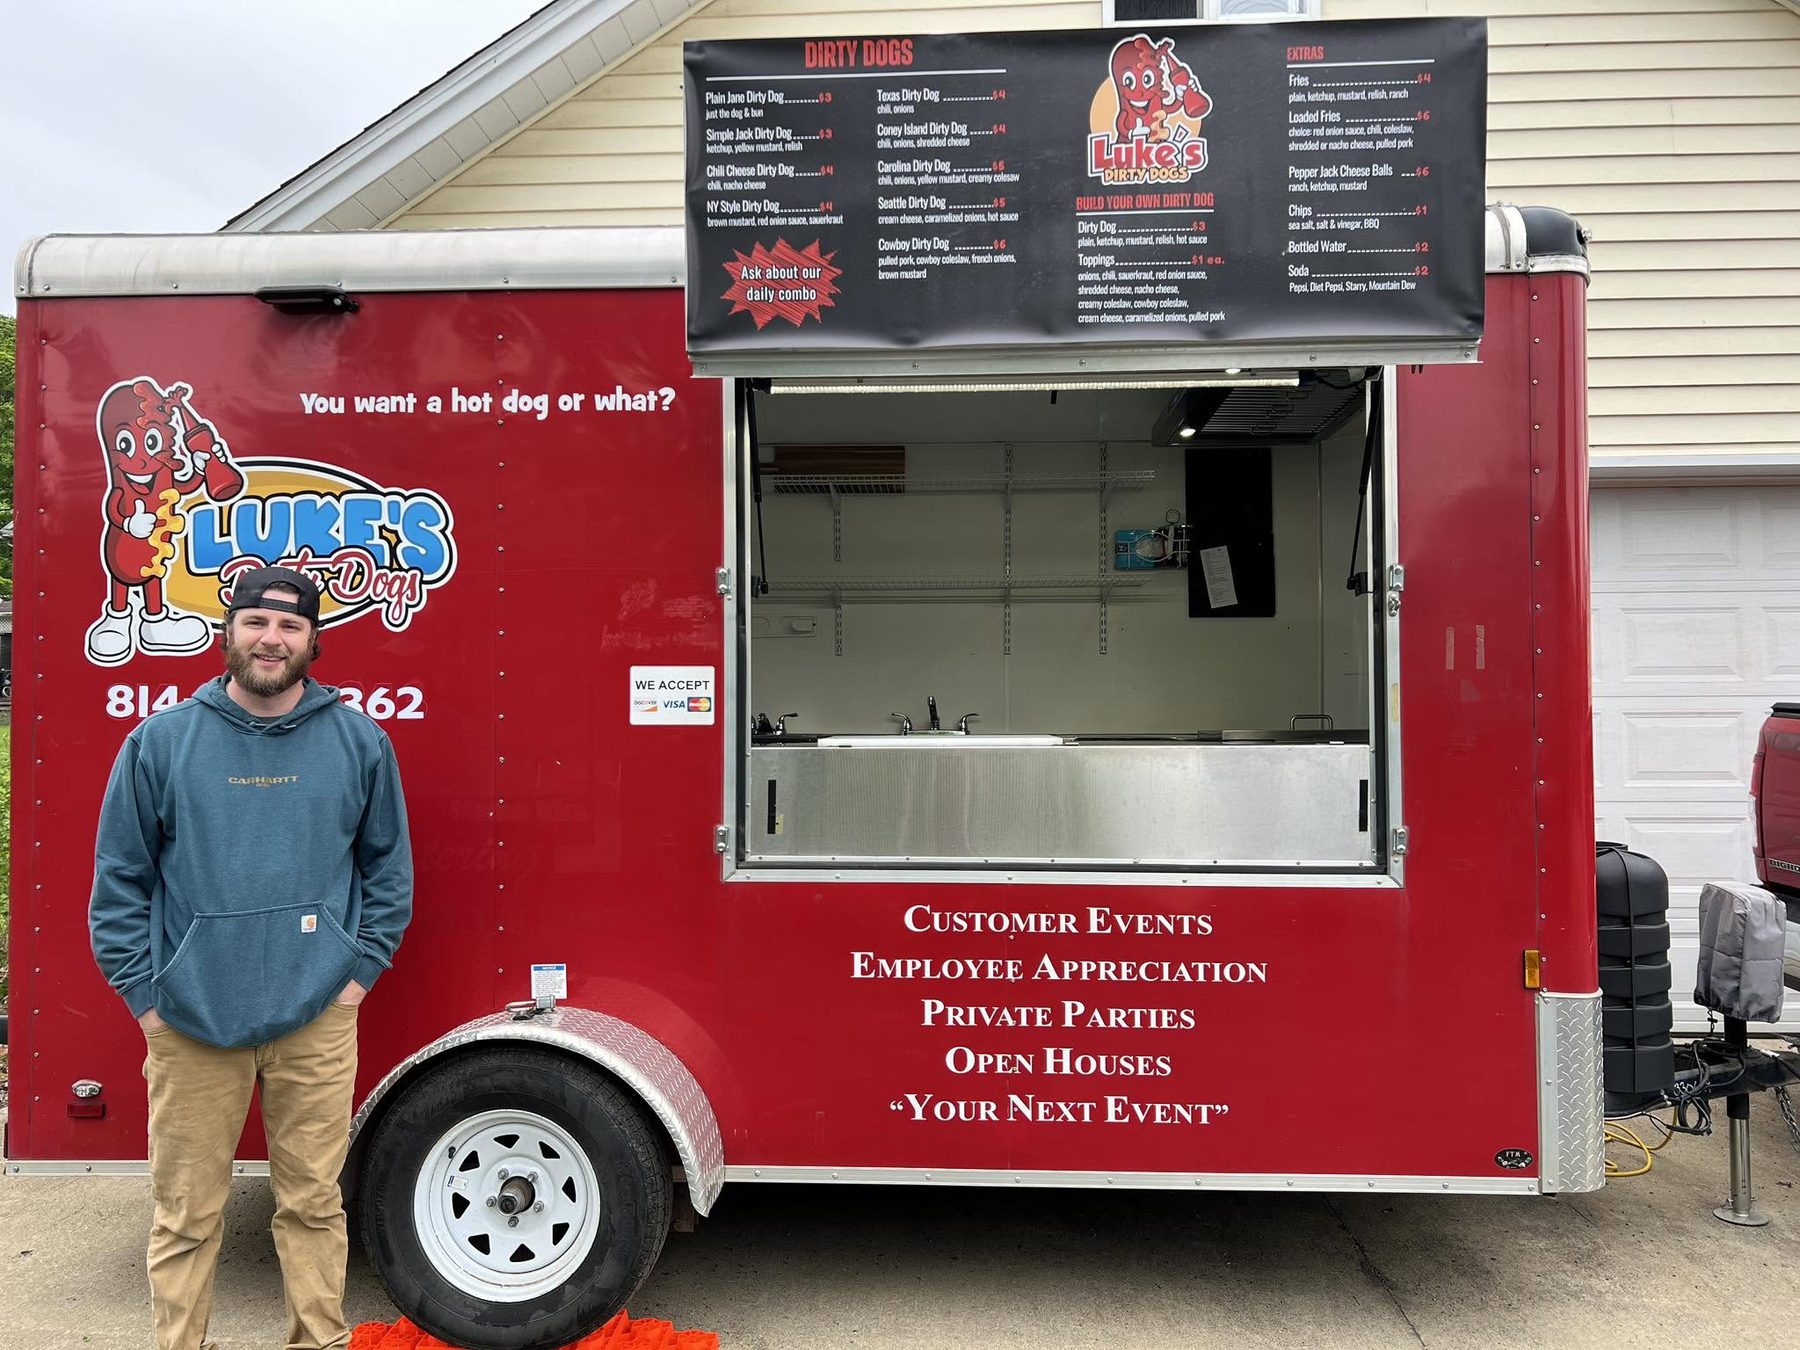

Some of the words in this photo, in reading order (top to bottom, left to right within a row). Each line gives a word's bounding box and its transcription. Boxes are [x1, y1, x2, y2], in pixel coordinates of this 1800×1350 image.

[805, 40, 857, 68] DIRTY
[864, 39, 913, 67] DOGS
[1287, 46, 1324, 61] EXTRAS
[1289, 74, 1309, 87] Fries
[706, 92, 725, 104] Plain
[727, 91, 744, 103] Jane
[747, 90, 766, 104] Dirty
[768, 90, 784, 104] Dog
[877, 90, 900, 101] Texas
[902, 89, 921, 102] Dirty
[924, 88, 939, 102] Dog
[706, 109, 717, 120] just
[719, 109, 729, 118] the
[731, 108, 743, 120] dog
[744, 107, 749, 118] &
[751, 107, 763, 117] bun
[878, 104, 892, 114] chili,
[894, 104, 914, 114] onions
[1289, 111, 1318, 123] Loaded
[1321, 110, 1340, 122] Fries
[707, 128, 733, 142] Simple
[736, 128, 753, 140] Jack
[755, 127, 774, 140] Dirty
[776, 127, 792, 140] Dog
[878, 124, 902, 137] Coney
[904, 123, 927, 135] Island
[930, 122, 949, 136] Dirty
[951, 122, 967, 136] Dog
[707, 165, 724, 177] Chili
[726, 165, 755, 176] Cheese
[758, 164, 776, 177] Dirty
[779, 164, 794, 177] Dog
[878, 160, 911, 172] Carolina
[913, 159, 932, 173] Dirty
[935, 159, 950, 173] Dog
[1289, 166, 1318, 180] Pepper
[1320, 166, 1338, 178] Jack
[1340, 165, 1370, 177] Cheese
[1373, 164, 1393, 176] Balls
[1105, 168, 1145, 182] DIRTY
[1150, 167, 1187, 180] DOGS
[708, 181, 722, 191] chili,
[724, 180, 742, 190] nacho
[744, 180, 766, 190] cheese
[1289, 182, 1309, 192] ranch,
[1310, 182, 1338, 192] ketchup,
[1340, 181, 1367, 191] mustard
[707, 201, 719, 212] NY
[721, 200, 740, 214] Style
[743, 200, 762, 213] Dirty
[764, 199, 779, 213] Dog
[878, 197, 907, 209] Seattle
[909, 196, 928, 210] Dirty
[930, 196, 946, 210] Dog
[1076, 197, 1104, 210] BUILD
[1107, 196, 1133, 209] YOUR
[1136, 195, 1160, 208] OWN
[1163, 193, 1191, 207] DIRTY
[1194, 192, 1213, 207] DOG
[1289, 204, 1312, 218] Chips
[708, 217, 727, 227] brown
[729, 217, 756, 227] mustard,
[758, 216, 768, 226] red
[770, 216, 787, 225] onion
[788, 216, 808, 225] sauce,
[809, 215, 843, 225] sauerkraut
[1078, 222, 1098, 234] Dirty
[1100, 221, 1116, 233] Dog
[1289, 221, 1300, 230] sea
[1302, 220, 1315, 230] salt,
[1316, 220, 1328, 230] salt
[1330, 220, 1335, 229] &
[1337, 219, 1362, 230] vinegar,
[1364, 219, 1379, 229] BBQ
[879, 238, 910, 252] Cowboy
[912, 238, 931, 251] Dirty
[934, 237, 949, 251] Dog
[1078, 238, 1095, 248] plain,
[1097, 237, 1124, 247] ketchup,
[1126, 235, 1154, 245] mustard,
[1156, 235, 1175, 245] relish,
[1177, 234, 1187, 244] hot
[1189, 235, 1207, 244] sauce
[1289, 241, 1319, 253] Bottled
[1321, 241, 1346, 252] Water
[1078, 254, 1115, 268] Toppings
[1207, 256, 1224, 264] ea.
[741, 266, 762, 279] Ask
[766, 266, 798, 279] about
[803, 268, 821, 278] our
[879, 270, 898, 279] brown
[900, 269, 926, 279] mustard
[1289, 265, 1309, 277] Soda
[1289, 283, 1308, 293] Pepsi,
[1310, 282, 1323, 292] Diet
[1325, 282, 1344, 292] Pepsi,
[1346, 281, 1367, 292] Starry,
[1369, 280, 1400, 290] Mountain
[1401, 280, 1416, 289] Dew
[747, 287, 774, 302] daily
[779, 289, 816, 300] combo
[300, 393, 344, 413] You
[355, 393, 416, 413] want
[427, 396, 442, 413] a
[451, 387, 493, 413] hot
[502, 389, 549, 420] dog
[558, 391, 584, 412] or
[595, 385, 675, 412] what?
[191, 496, 447, 576] LUKE'S
[332, 551, 420, 621] Dogs
[635, 681, 655, 689] WE
[659, 681, 710, 690] ACCEPT
[904, 904, 1078, 935] CUSTOMER
[1086, 907, 1213, 936] EVENTS
[850, 951, 1023, 980] EMPLOYEE
[1032, 954, 1267, 983] APPRECIATION
[921, 999, 1052, 1027] PRIVATE
[1061, 1000, 1196, 1029] PARTIES
[945, 1046, 1034, 1074] OPEN
[1043, 1047, 1171, 1077] HOUSES
[1007, 1095, 1096, 1123] NEXT
